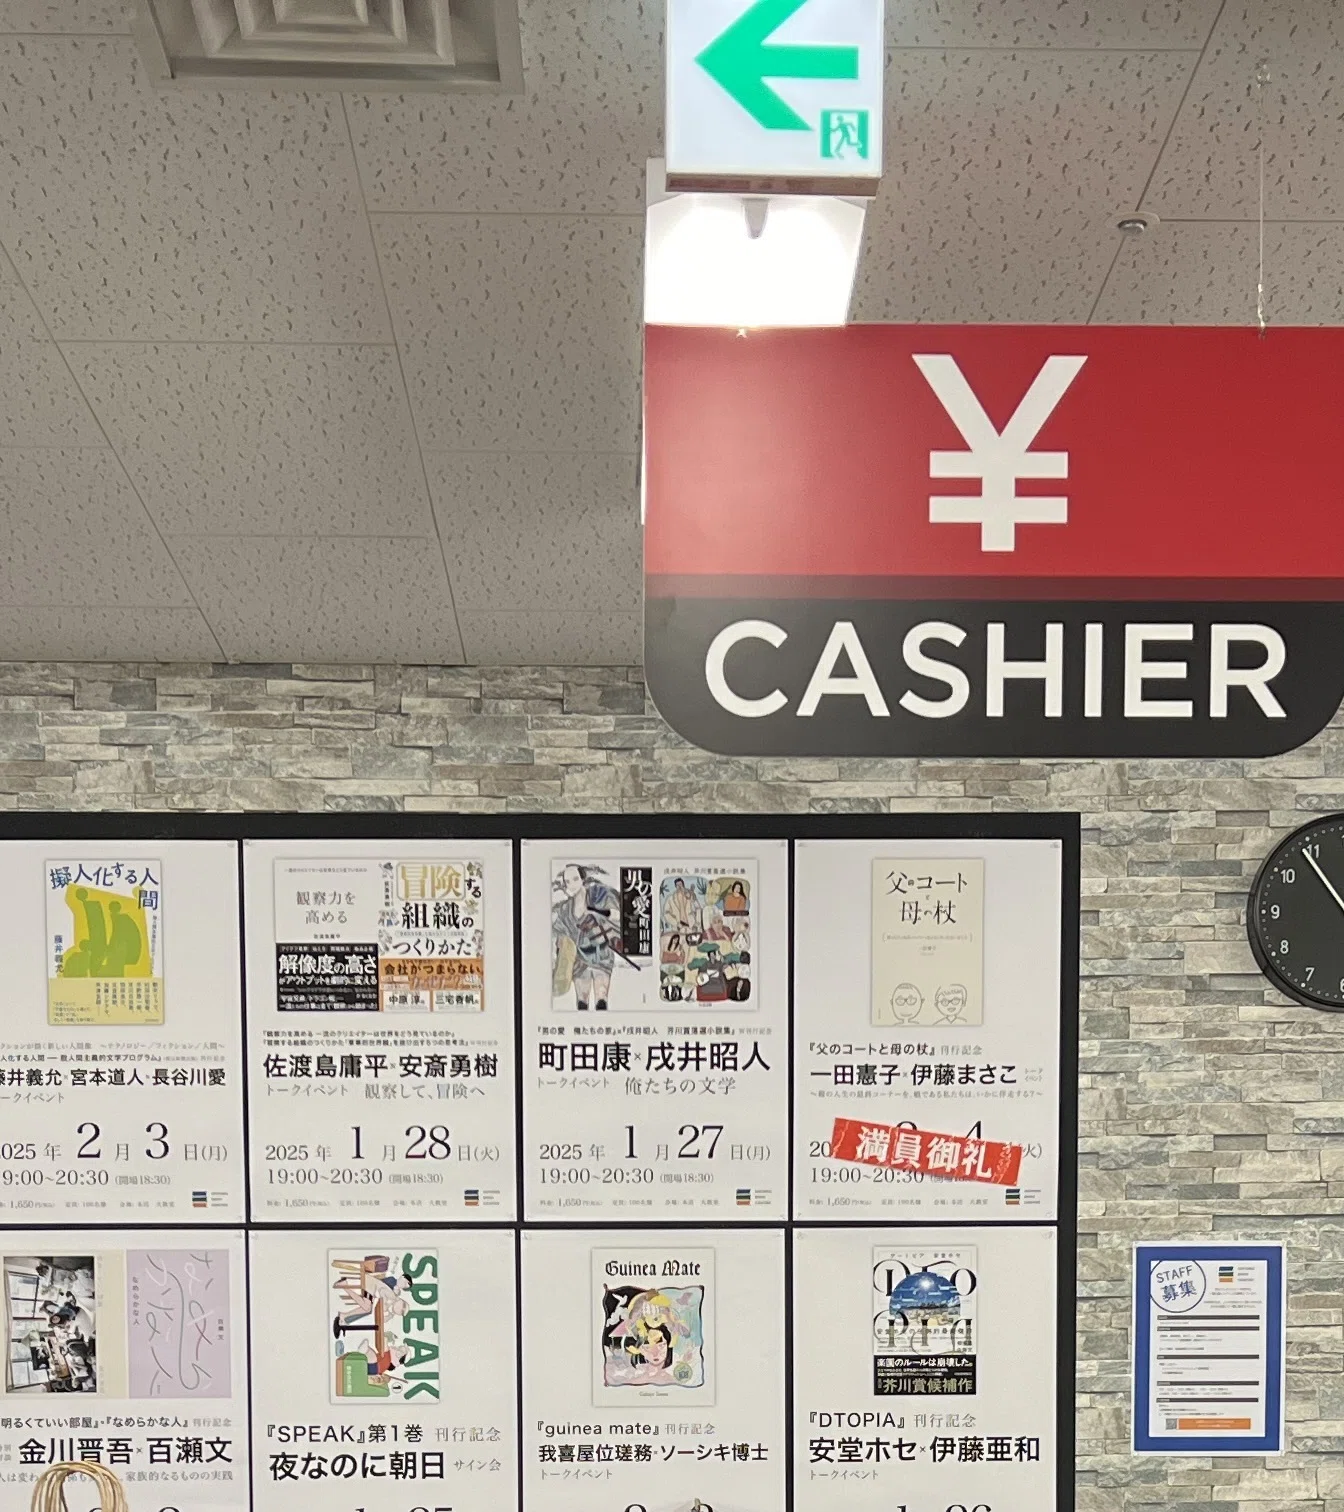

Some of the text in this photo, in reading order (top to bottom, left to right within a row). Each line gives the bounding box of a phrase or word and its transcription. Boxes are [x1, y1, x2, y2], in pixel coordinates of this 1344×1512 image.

[705, 619, 1287, 719] CASHIER
[1306, 844, 1319, 858] 11
[1280, 870, 1295, 883] 10
[296, 891, 356, 906] 観察力を
[305, 910, 348, 924] 高める
[401, 901, 474, 929] 組織の
[1270, 905, 1280, 919] 9
[392, 938, 472, 956] つくりかた
[1280, 940, 1289, 954] 8
[279, 954, 377, 974] 解像度の高さ
[1306, 967, 1315, 982] 7
[538, 1041, 771, 1072] 町田康×戌井昭人
[809, 1043, 982, 1056] 『父のコートと母の杖』 刊行記念
[810, 1064, 1017, 1086] 一田憲子×伊藤まさこ
[266, 1083, 486, 1100] トークイベント 観察して、冒険へ
[537, 1076, 736, 1096] トークイベント 俺たちの文学
[856, 1125, 993, 1179] 満員御礼
[605, 1258, 701, 1278] Guinea Mate
[1156, 1265, 1193, 1284] STAFF
[1161, 1280, 1197, 1303] 募集
[402, 1253, 439, 1400] SPEAK
[193, 1418, 232, 1428] 刊行記念
[537, 1421, 716, 1437] 『guinea mate』 刊行記念
[809, 1411, 976, 1429] 『DTOPIA』 刊行記念
[267, 1423, 502, 1444] 『SPEAK』第1巻 刊行記念
[18, 1436, 233, 1465] 金川晋吾×百瀬文
[809, 1435, 1041, 1463] 安堂ホセ×伊藤亜和
[269, 1451, 501, 1480] 夜なのに朝日 サイン会
[540, 1469, 612, 1480] トークイベント
[809, 1469, 878, 1481] トークイベント
